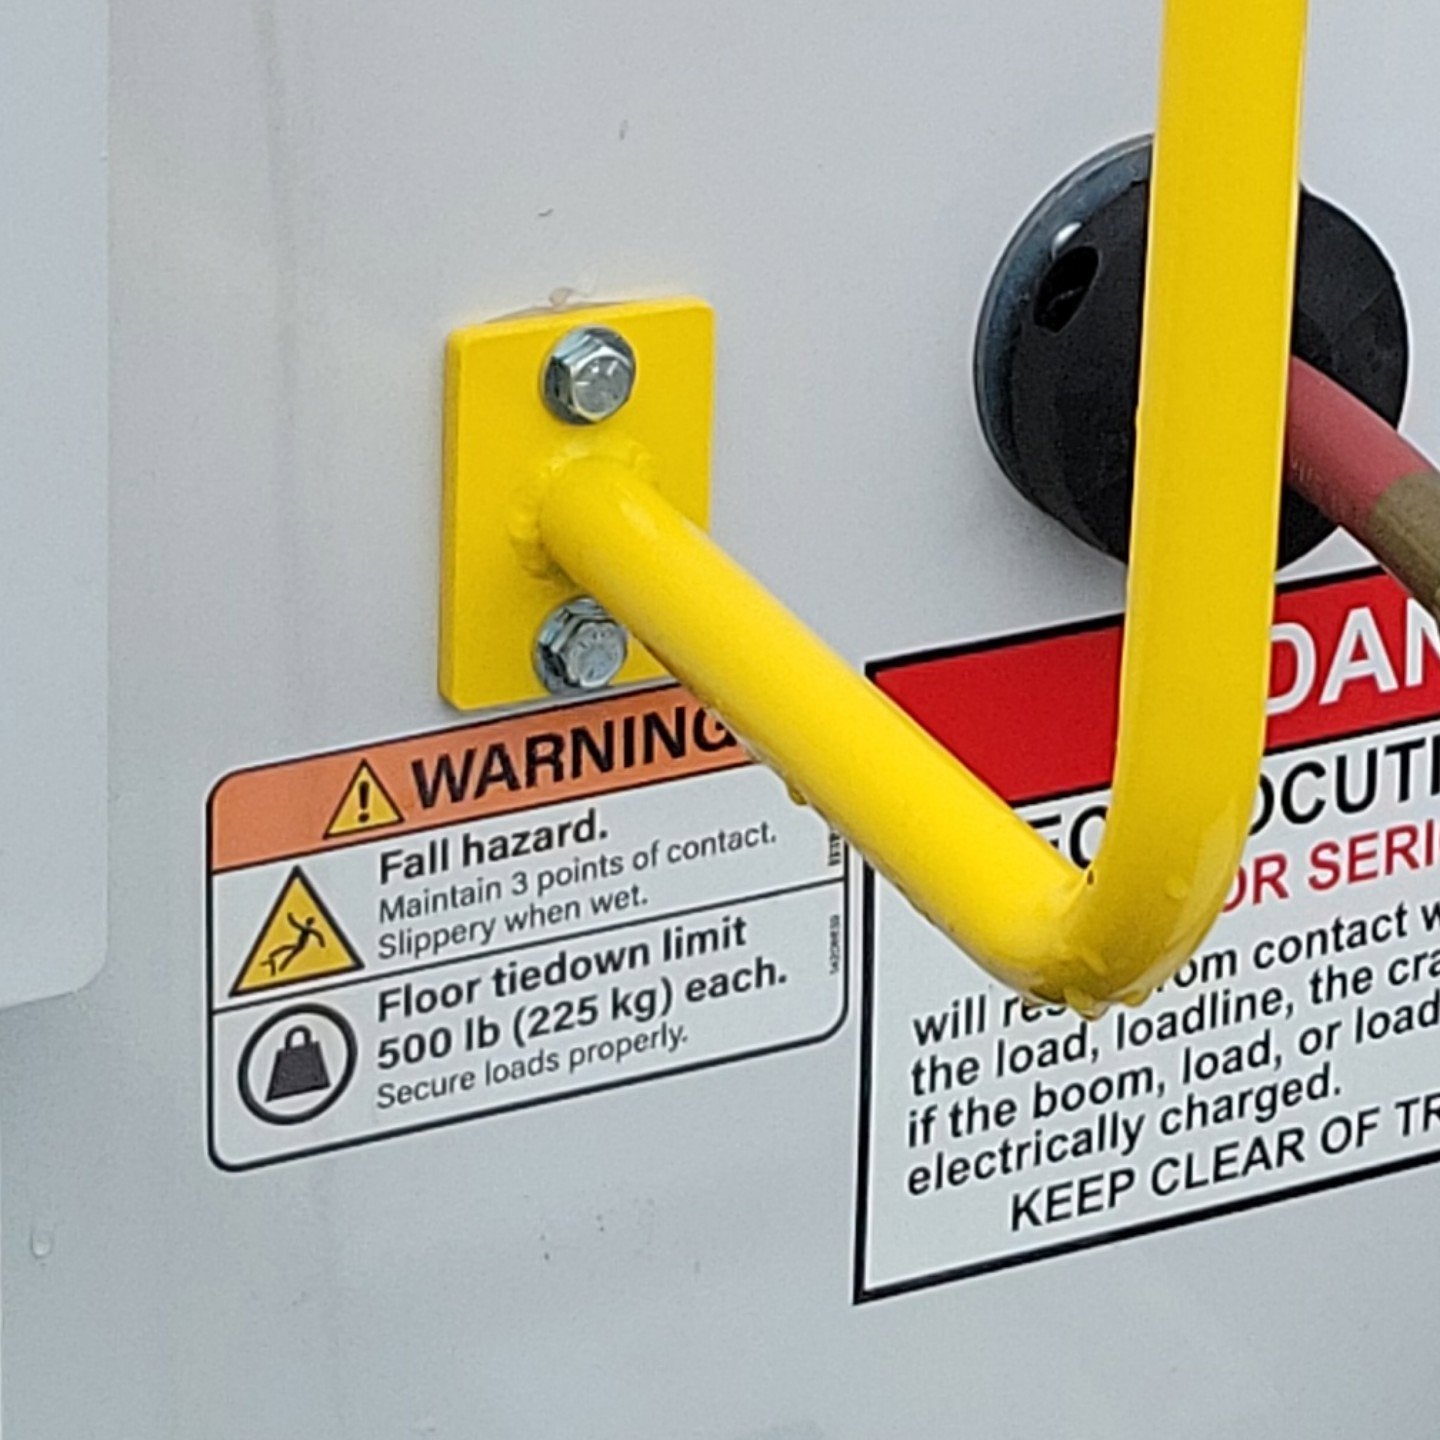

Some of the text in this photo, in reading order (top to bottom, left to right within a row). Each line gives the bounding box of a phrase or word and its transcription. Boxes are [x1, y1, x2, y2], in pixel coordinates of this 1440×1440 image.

[410, 705, 738, 809] WARNING
[381, 808, 609, 884] Fall hazard.
[381, 822, 778, 922] Maintain 3 points of contact.
[378, 886, 648, 960] Slippery when wet.
[379, 917, 745, 1022] Floor tiedown limit
[379, 957, 785, 1069] 500 lb (225 kg) each.
[913, 1056, 979, 1096] the
[998, 1021, 1098, 1076] load,
[1118, 986, 1293, 1049] loadline,
[1310, 966, 1372, 1004] the
[914, 995, 985, 1045] will
[1253, 915, 1409, 970] contact
[379, 1023, 689, 1108] Secure loads properly.
[910, 1106, 937, 1147] if
[950, 1098, 1016, 1137] the
[1034, 1067, 1164, 1118] boom,
[1183, 1029, 1281, 1083] load,
[1300, 1022, 1341, 1055] or
[908, 1062, 1339, 1196] electrically charged.
[1013, 1169, 1134, 1231] KEEP
[1152, 1128, 1304, 1195] CLEAR
[1322, 1108, 1379, 1154] OF
